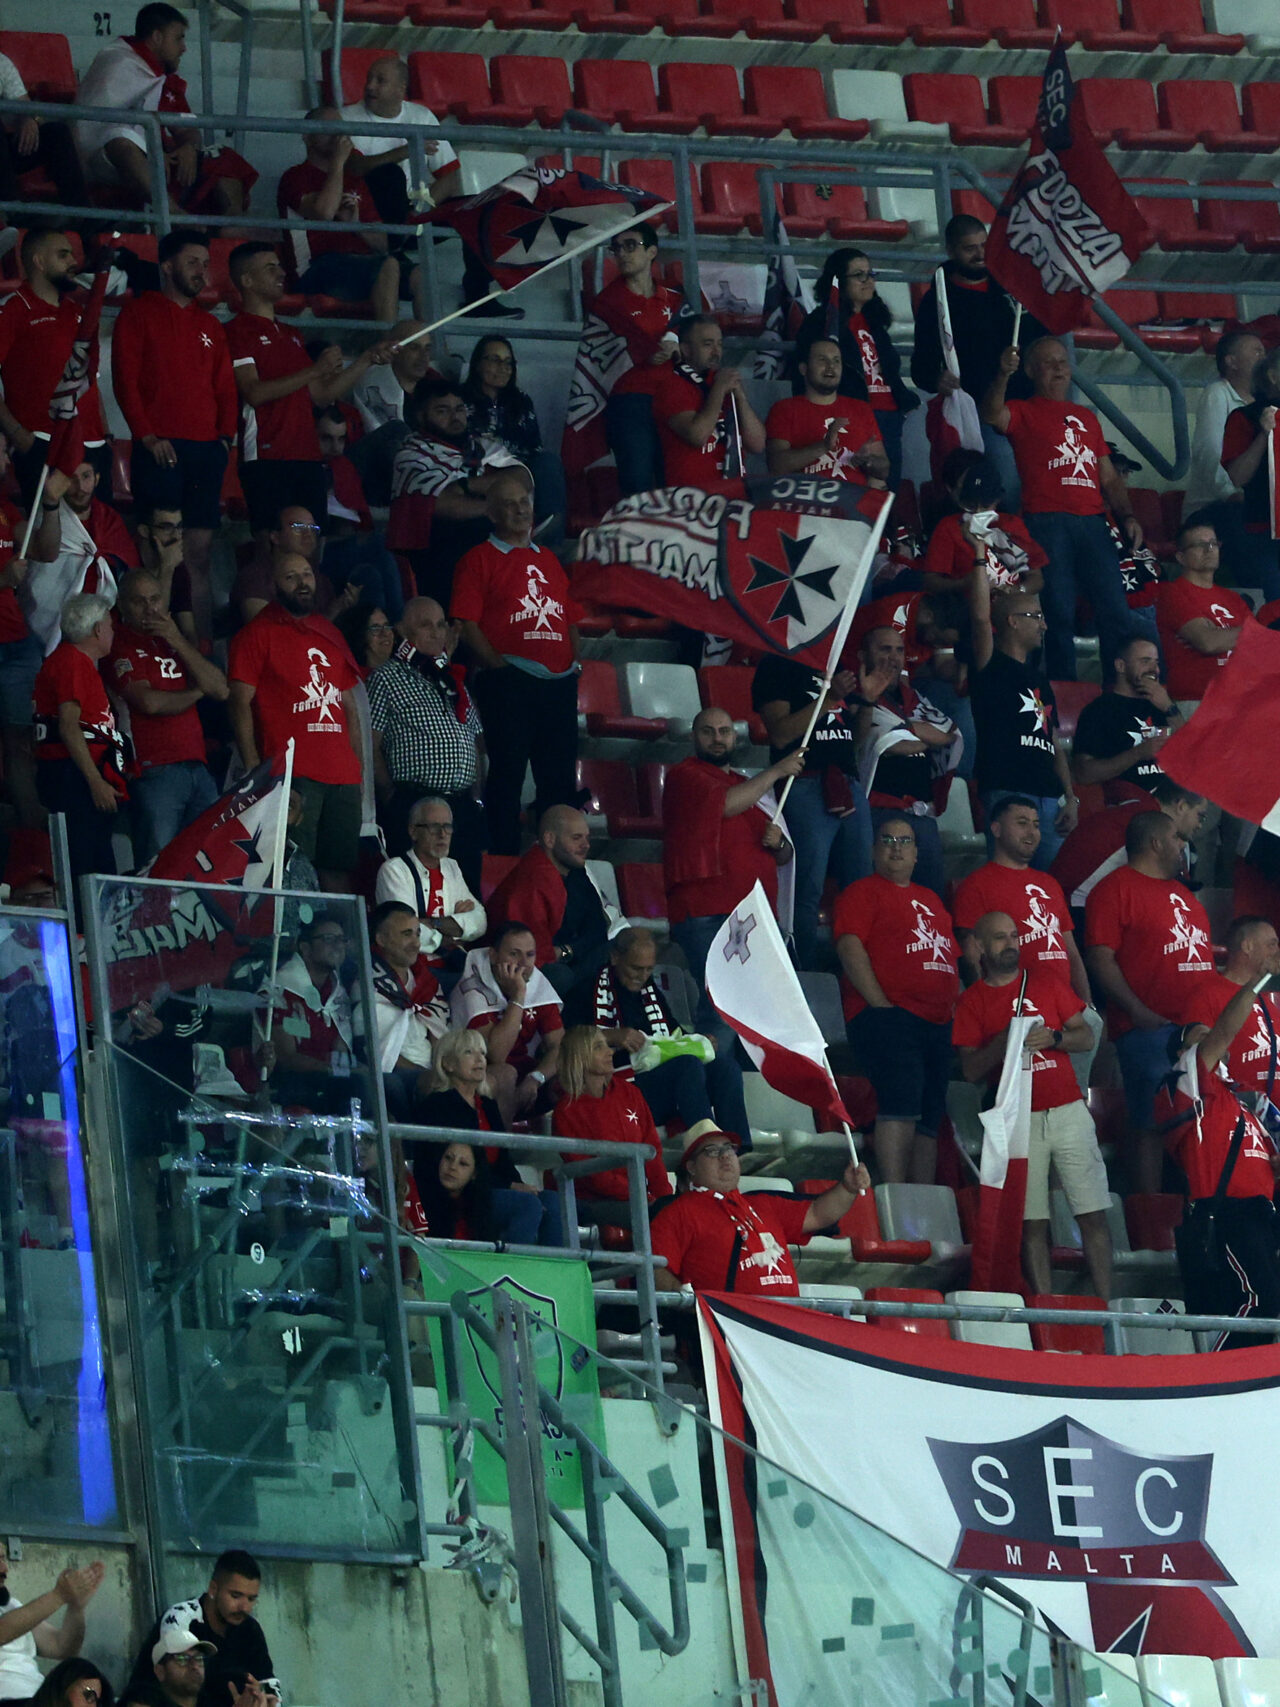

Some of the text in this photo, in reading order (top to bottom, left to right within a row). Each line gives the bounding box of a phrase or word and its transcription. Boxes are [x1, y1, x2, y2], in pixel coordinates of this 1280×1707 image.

[1043, 67, 1067, 128] SEC
[154, 656, 182, 679] 22
[815, 728, 853, 742] MALTA
[1020, 734, 1056, 757] MALTA
[971, 1446, 1183, 1536] SEC
[1005, 1544, 1176, 1575] MALTA
